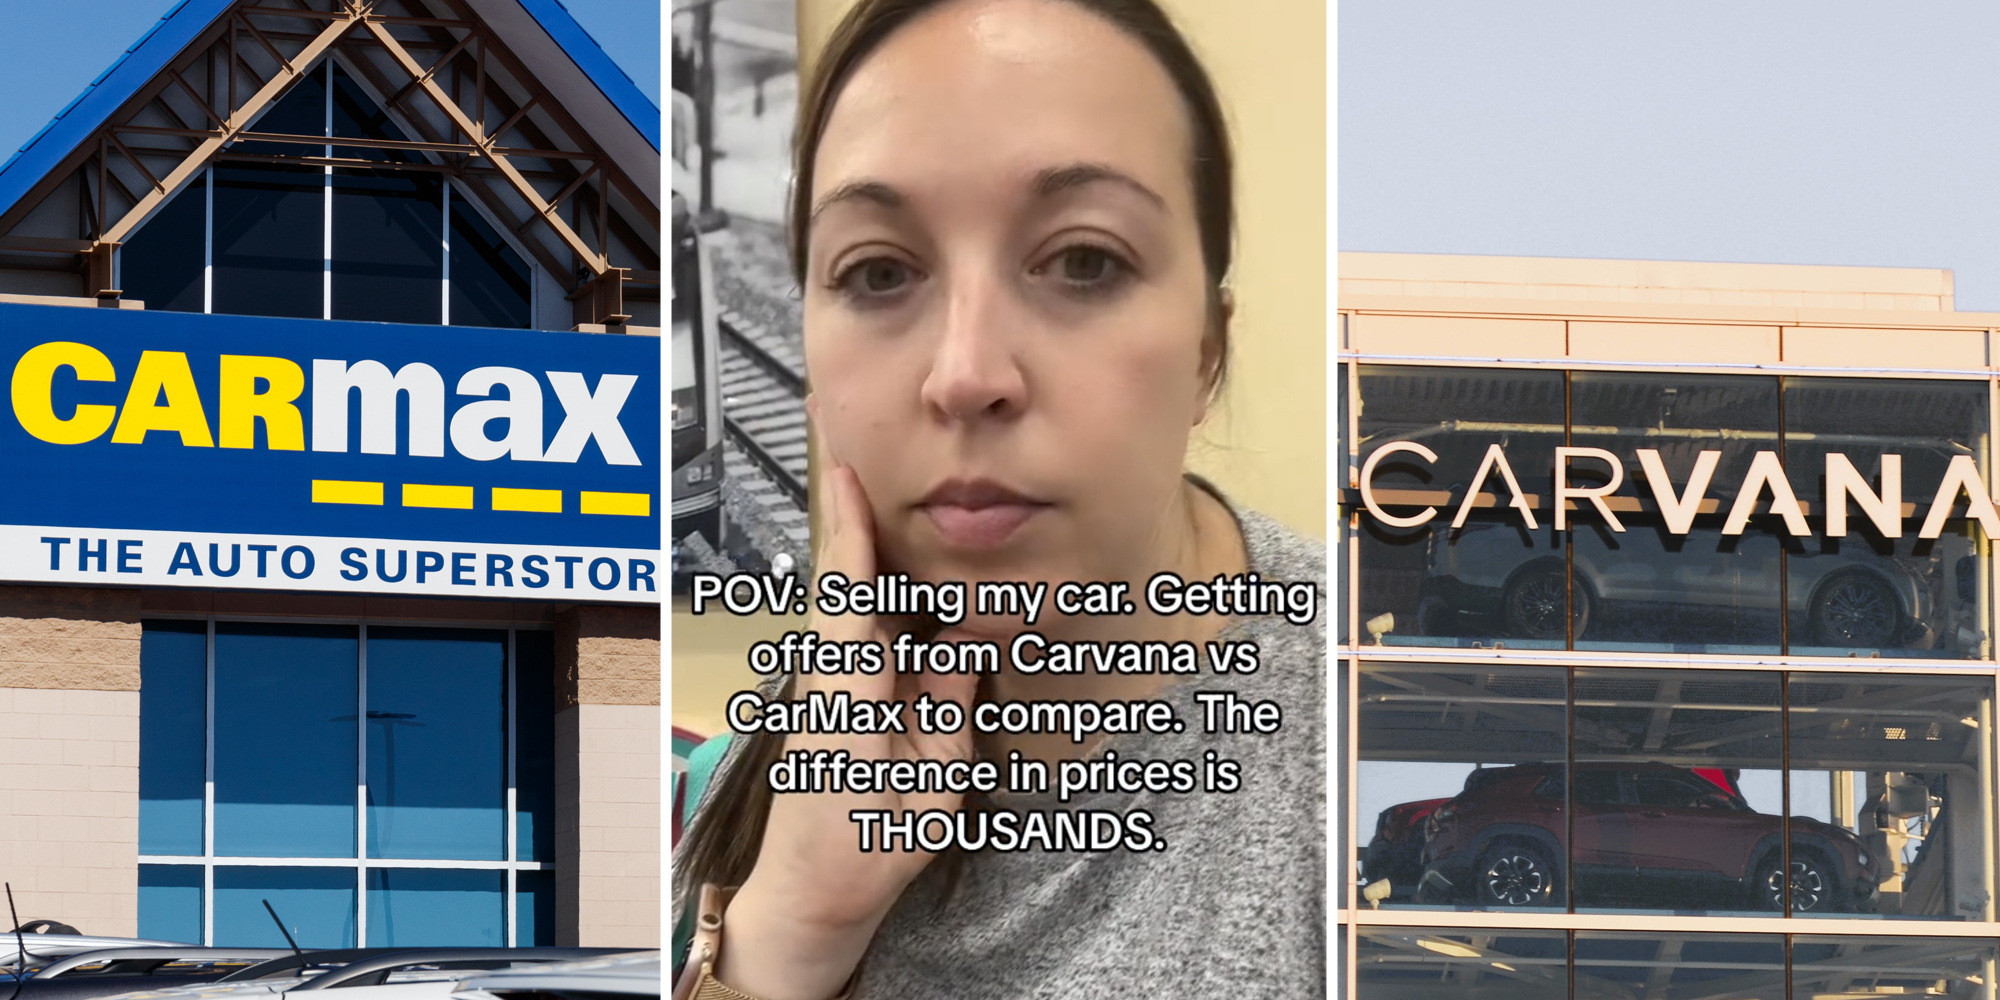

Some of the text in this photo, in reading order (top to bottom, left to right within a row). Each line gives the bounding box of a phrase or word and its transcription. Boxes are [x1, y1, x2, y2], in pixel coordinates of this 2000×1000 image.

[11, 341, 642, 466] CARmax
[1360, 440, 2000, 539] CARVANA
[41, 536, 656, 592] THE AUTO SUPERSTOR
